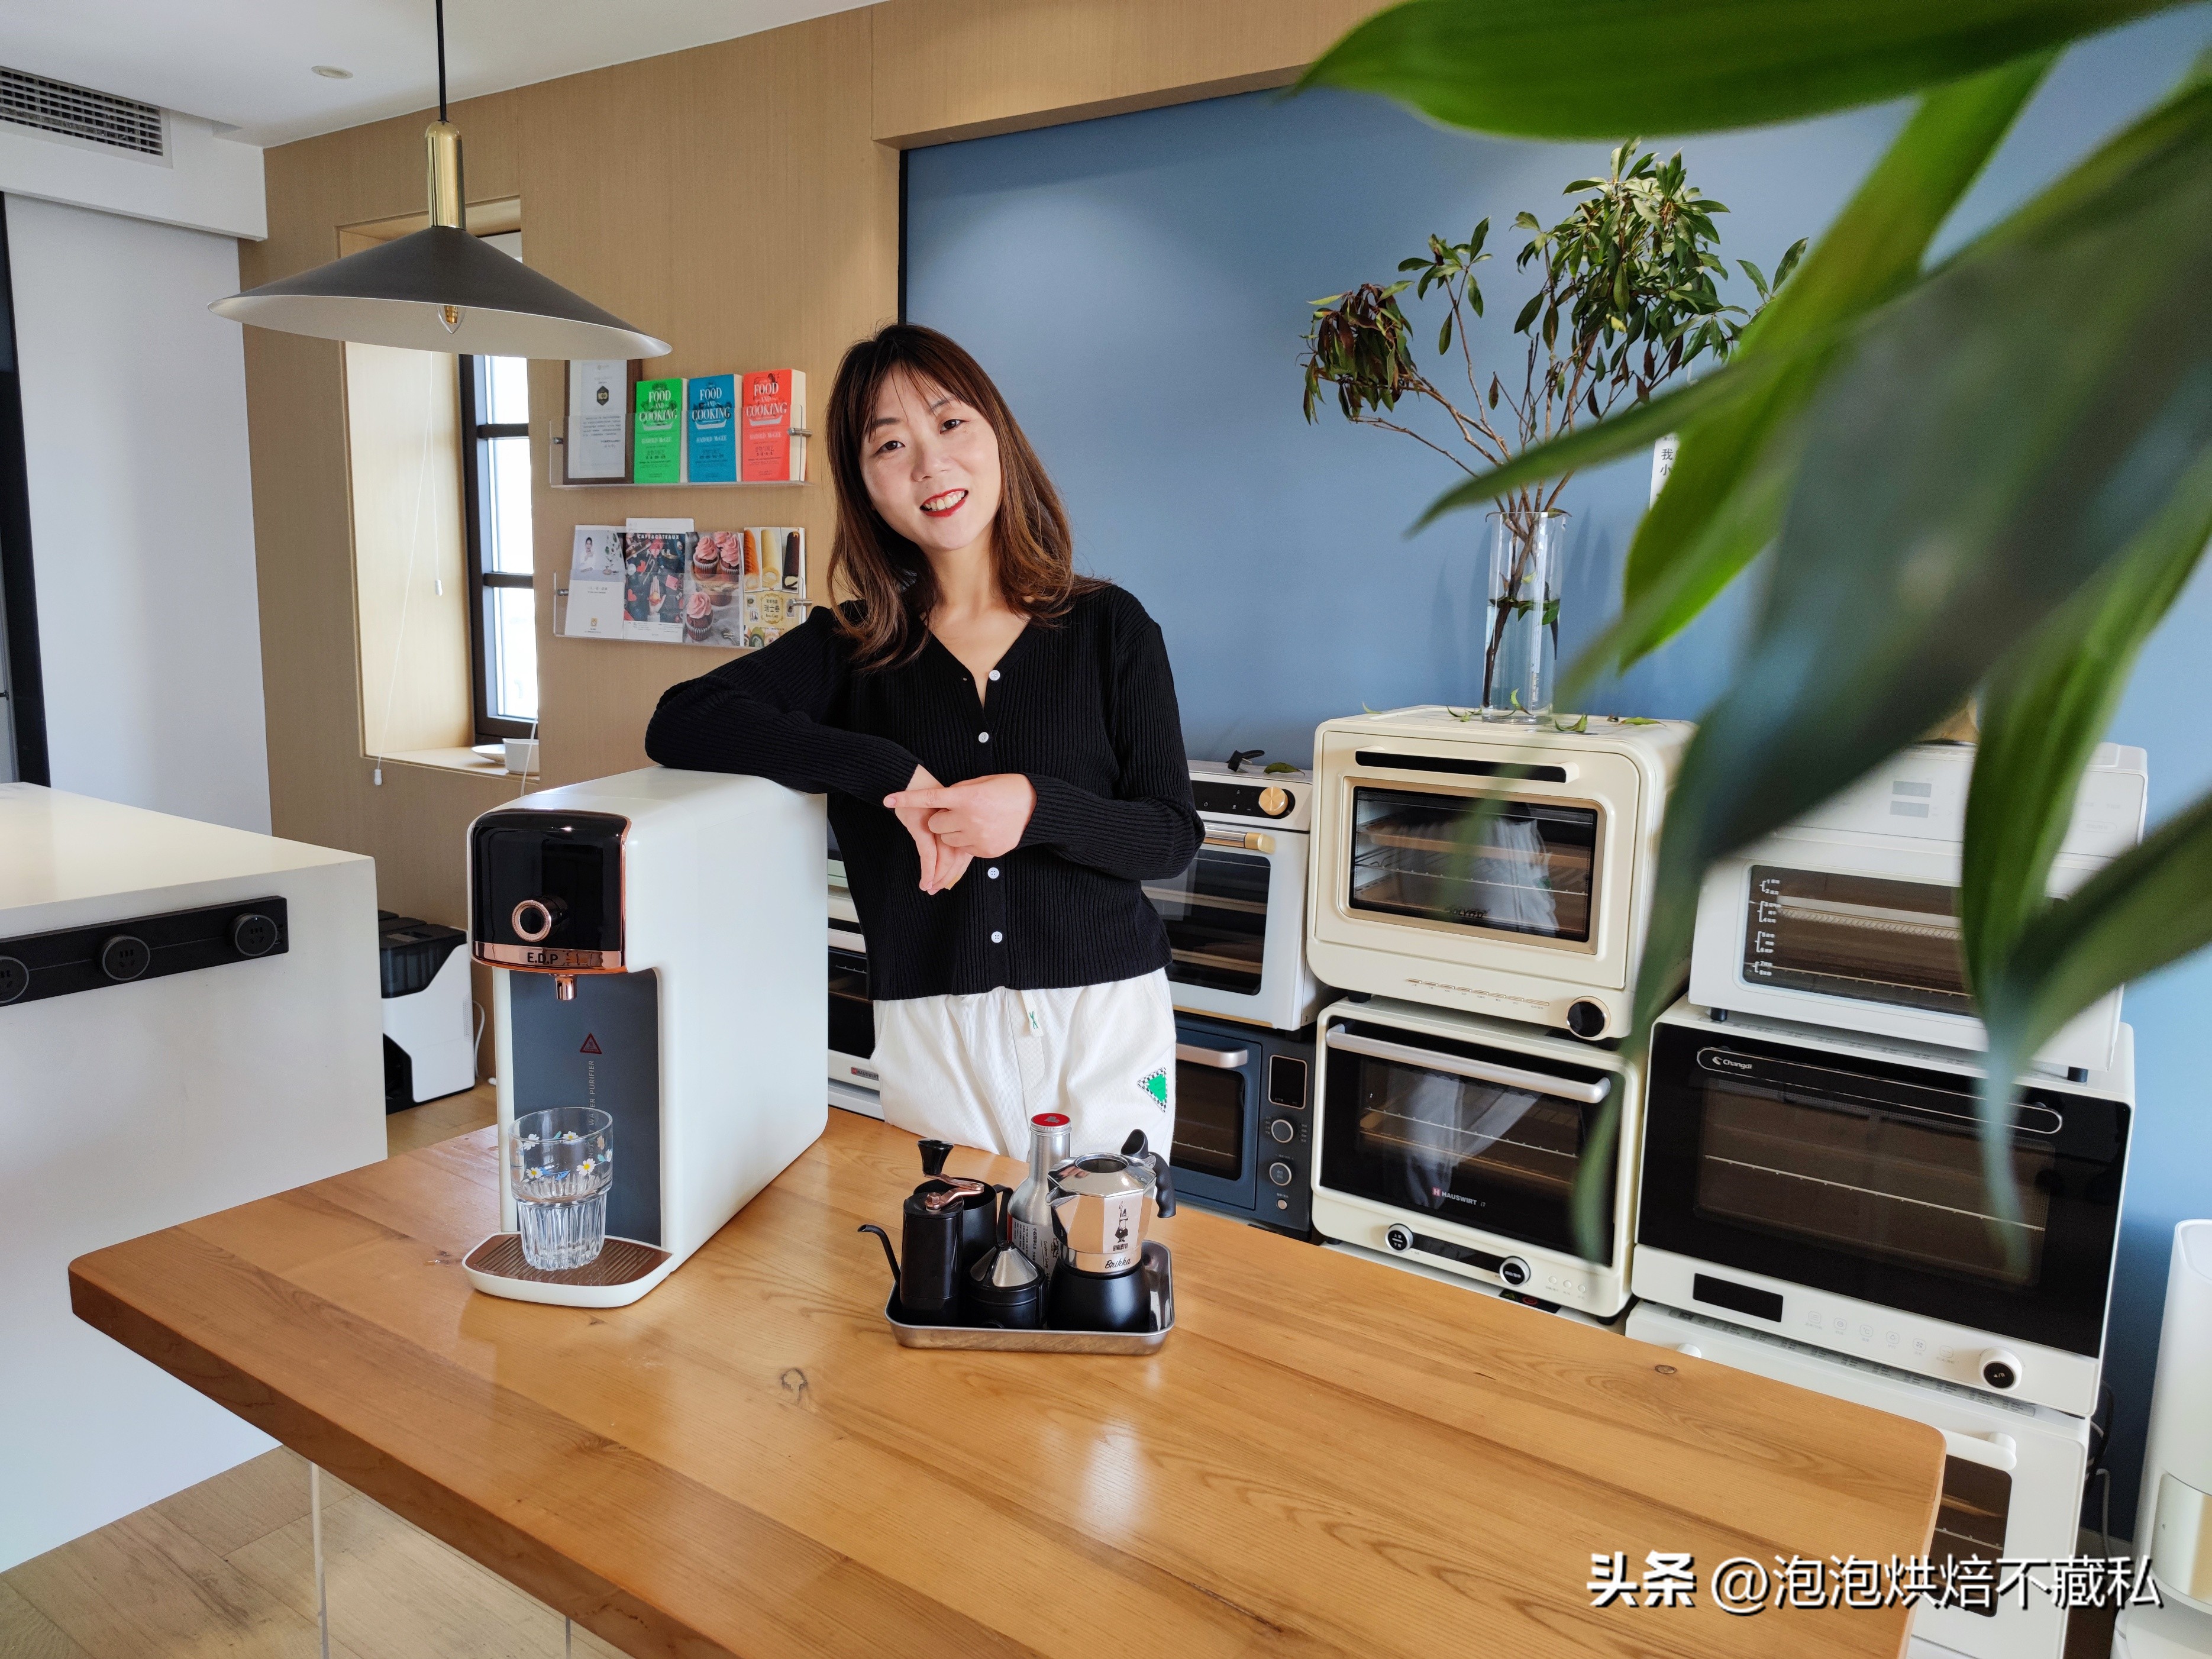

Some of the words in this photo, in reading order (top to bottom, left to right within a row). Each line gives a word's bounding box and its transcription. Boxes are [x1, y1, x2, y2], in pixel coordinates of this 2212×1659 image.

[700, 387, 722, 401] FOOD
[754, 382, 779, 396] FOOD
[648, 390, 671, 403] FOOD
[639, 409, 678, 422] COOKING
[692, 406, 731, 421] COOKING
[746, 402, 787, 417] COOKING
[527, 952, 558, 964] E.D.P
[1723, 1059, 1752, 1070] Changdi
[1442, 1191, 1478, 1205] HAUSWIRT
[1105, 1257, 1131, 1269] Brikka
